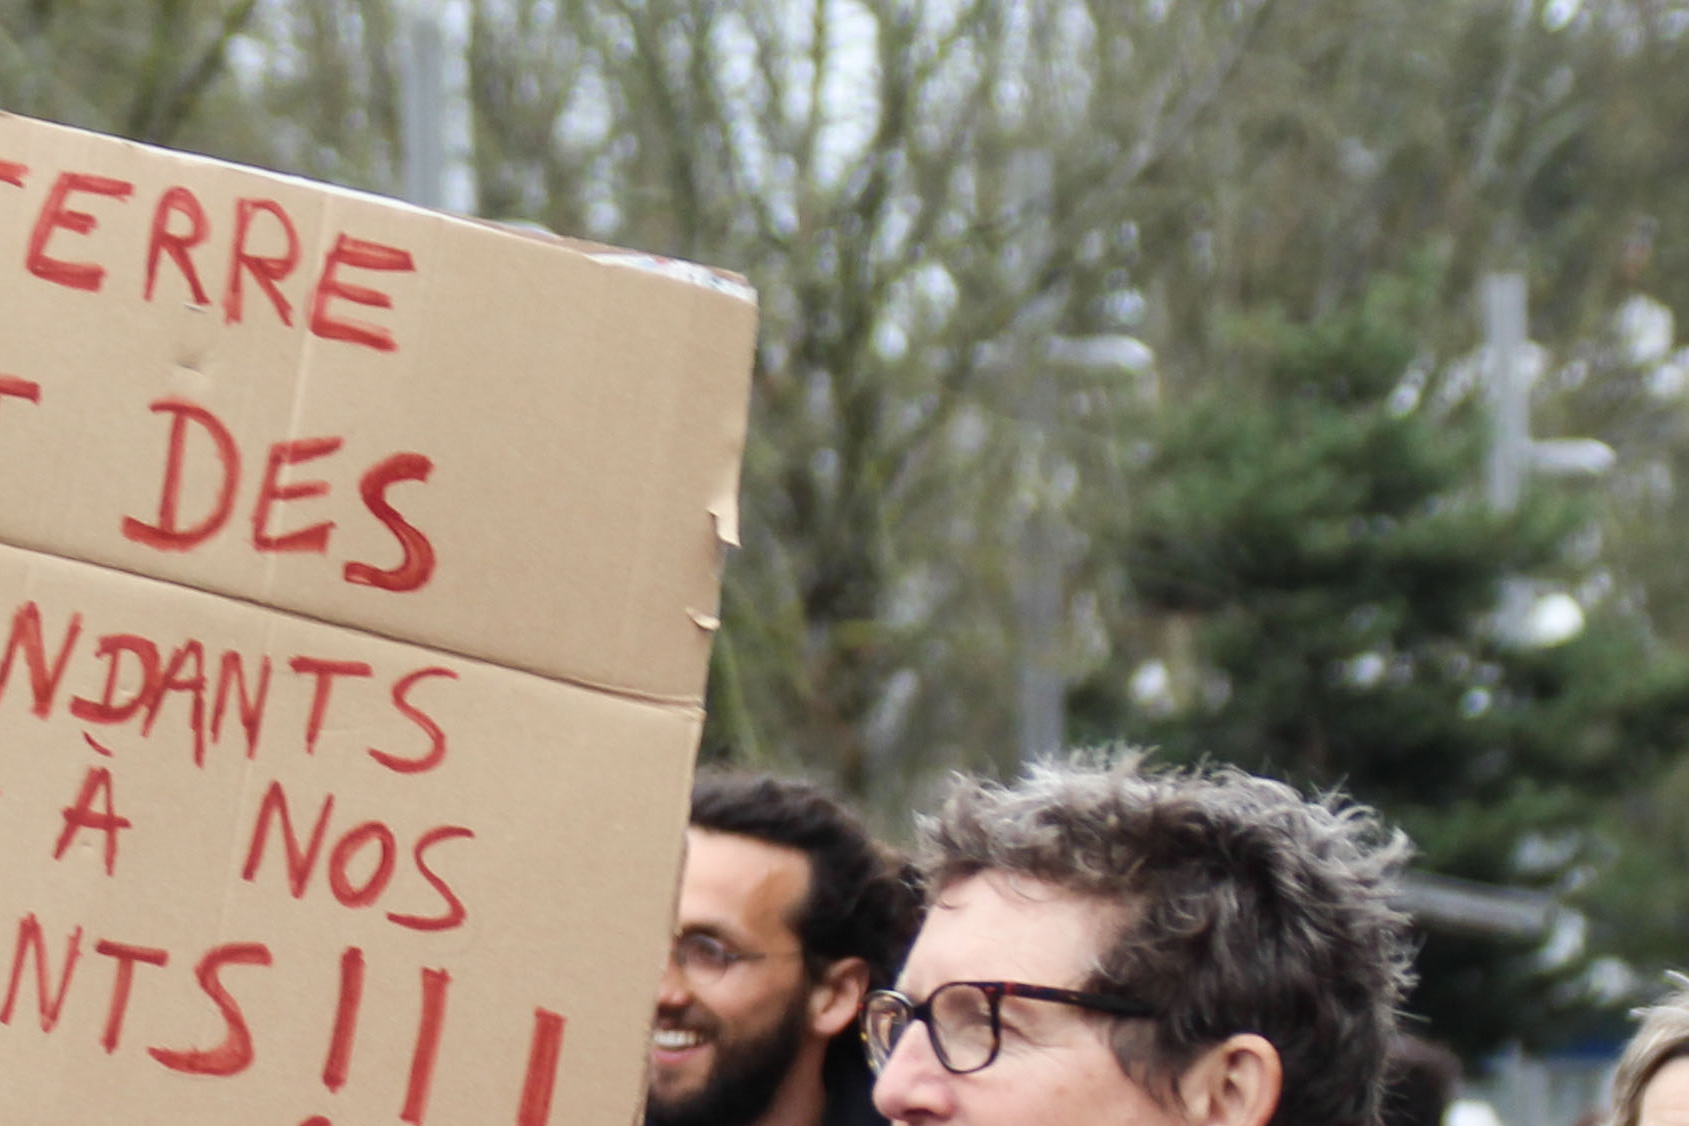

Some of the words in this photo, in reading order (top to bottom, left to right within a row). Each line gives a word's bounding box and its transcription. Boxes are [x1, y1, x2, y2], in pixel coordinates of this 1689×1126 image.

[121, 398, 436, 593] DES
[53, 731, 132, 876] À
[241, 781, 475, 932] NOS
